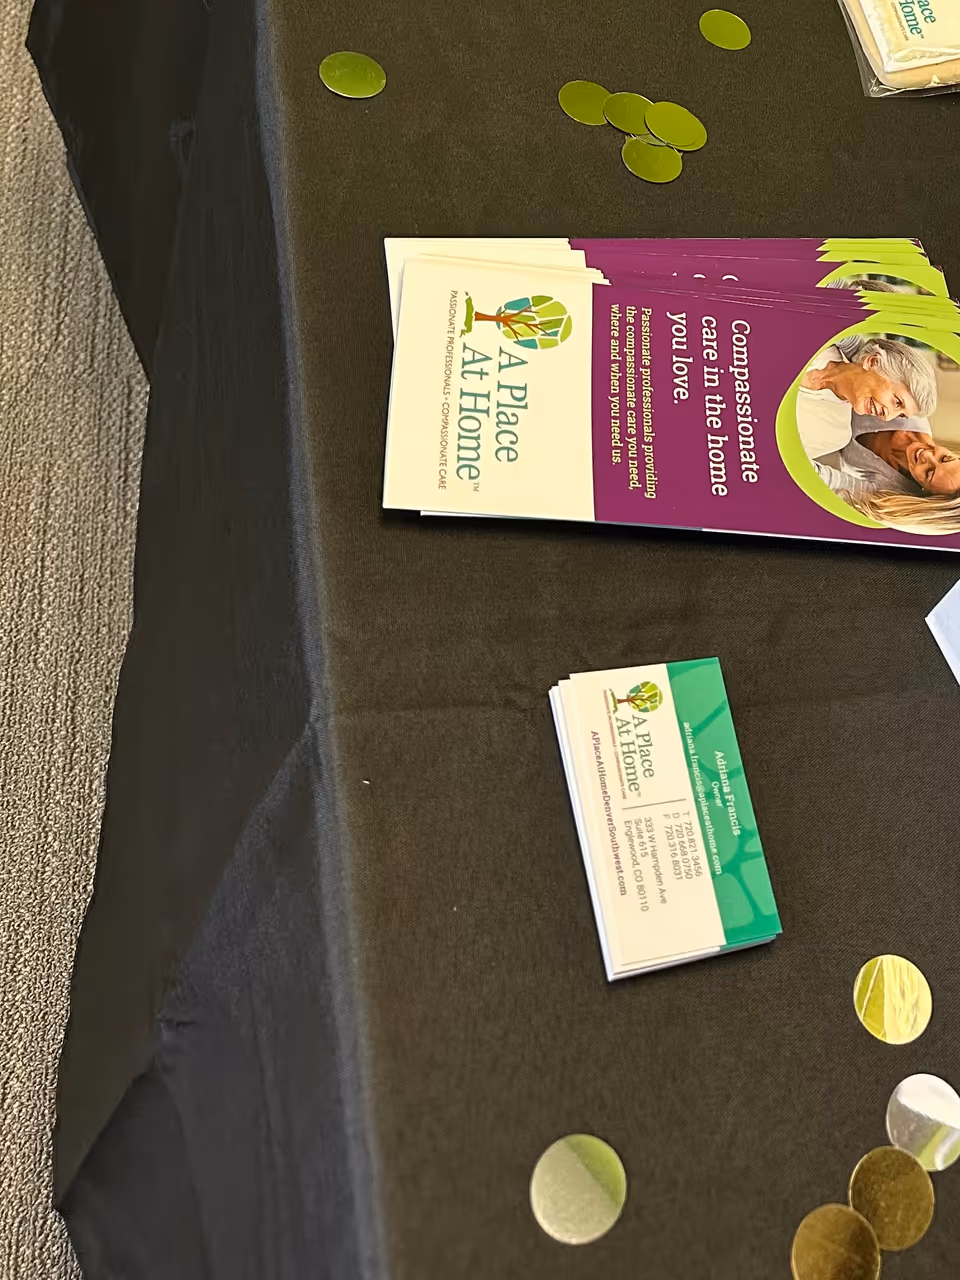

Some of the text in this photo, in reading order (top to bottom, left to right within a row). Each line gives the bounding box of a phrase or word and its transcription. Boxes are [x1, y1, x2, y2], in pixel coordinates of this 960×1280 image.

[438, 289, 458, 489] PASSIONATE PROFESSIONALS COMPASSIONATE CARE
[460, 342, 492, 380] At
[607, 303, 623, 464] where and when you need us.
[623, 305, 640, 489] the compassionate care you need,
[639, 307, 658, 498] Passionate professionals providing
[666, 311, 693, 403] you love.
[729, 319, 759, 482] Compassionate
[494, 345, 529, 462] A Place
[701, 316, 728, 495] care in the home
[615, 716, 631, 737] At
[631, 711, 654, 778] A Place
[590, 730, 626, 895] APlaceAtHomeDenverSouthwest.com
[634, 818, 648, 857] Suite 615
[711, 781, 723, 807] Owner
[714, 750, 740, 835] Adriana Francis
[623, 819, 649, 911] Englewood, CO 80110
[643, 816, 667, 904] 333 W Hampden Ave
